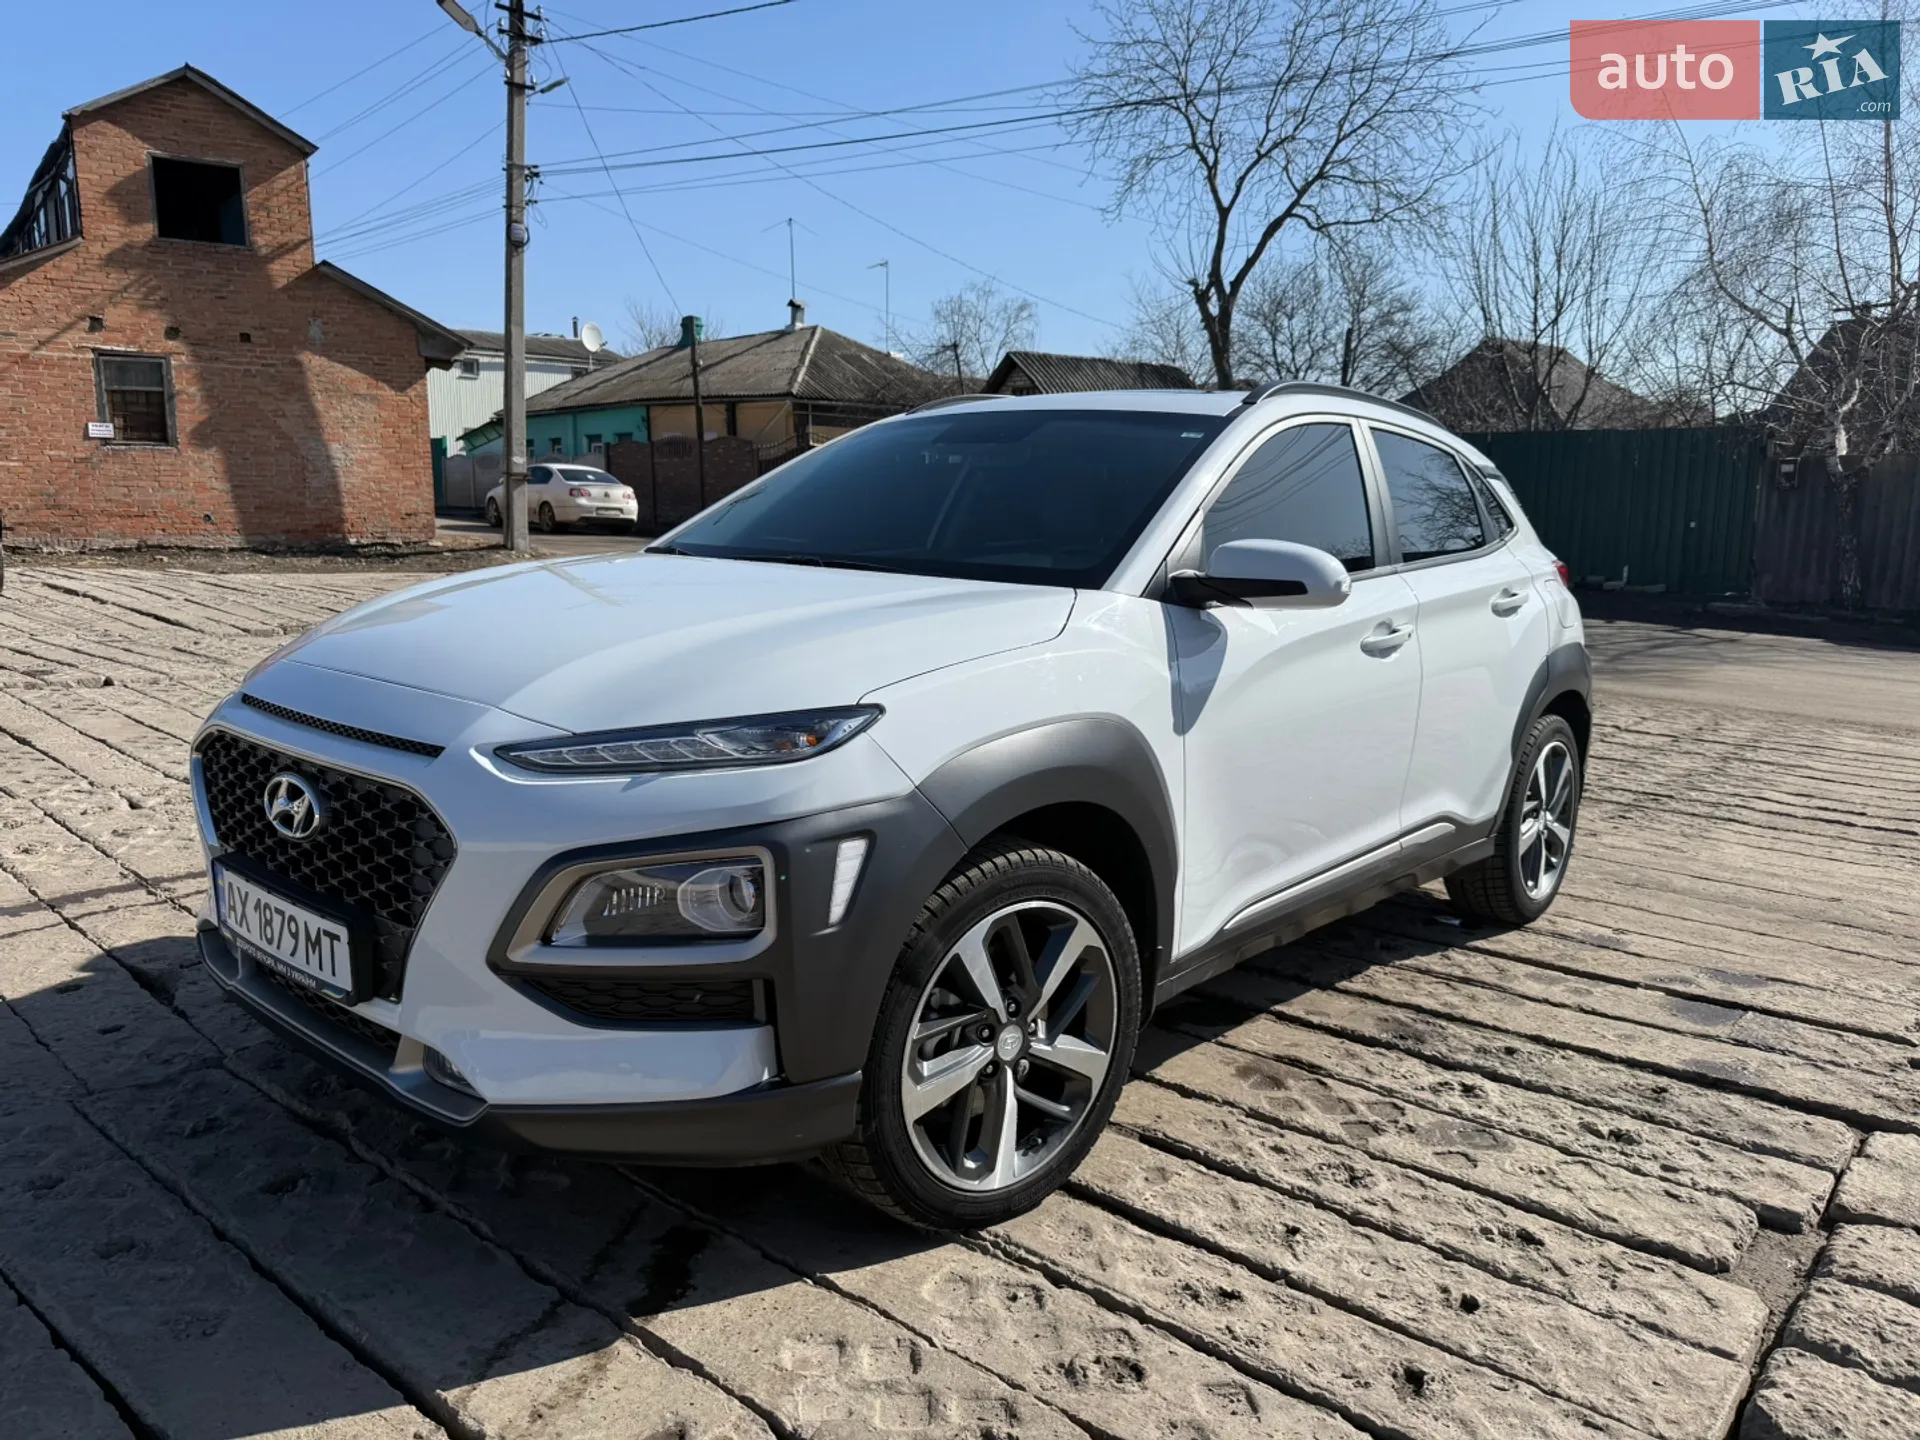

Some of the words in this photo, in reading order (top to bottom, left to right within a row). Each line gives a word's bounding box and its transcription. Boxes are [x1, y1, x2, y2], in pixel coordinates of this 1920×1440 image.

[228, 881, 251, 934] AX
[253, 898, 300, 958] 1879
[304, 920, 342, 977] MT
